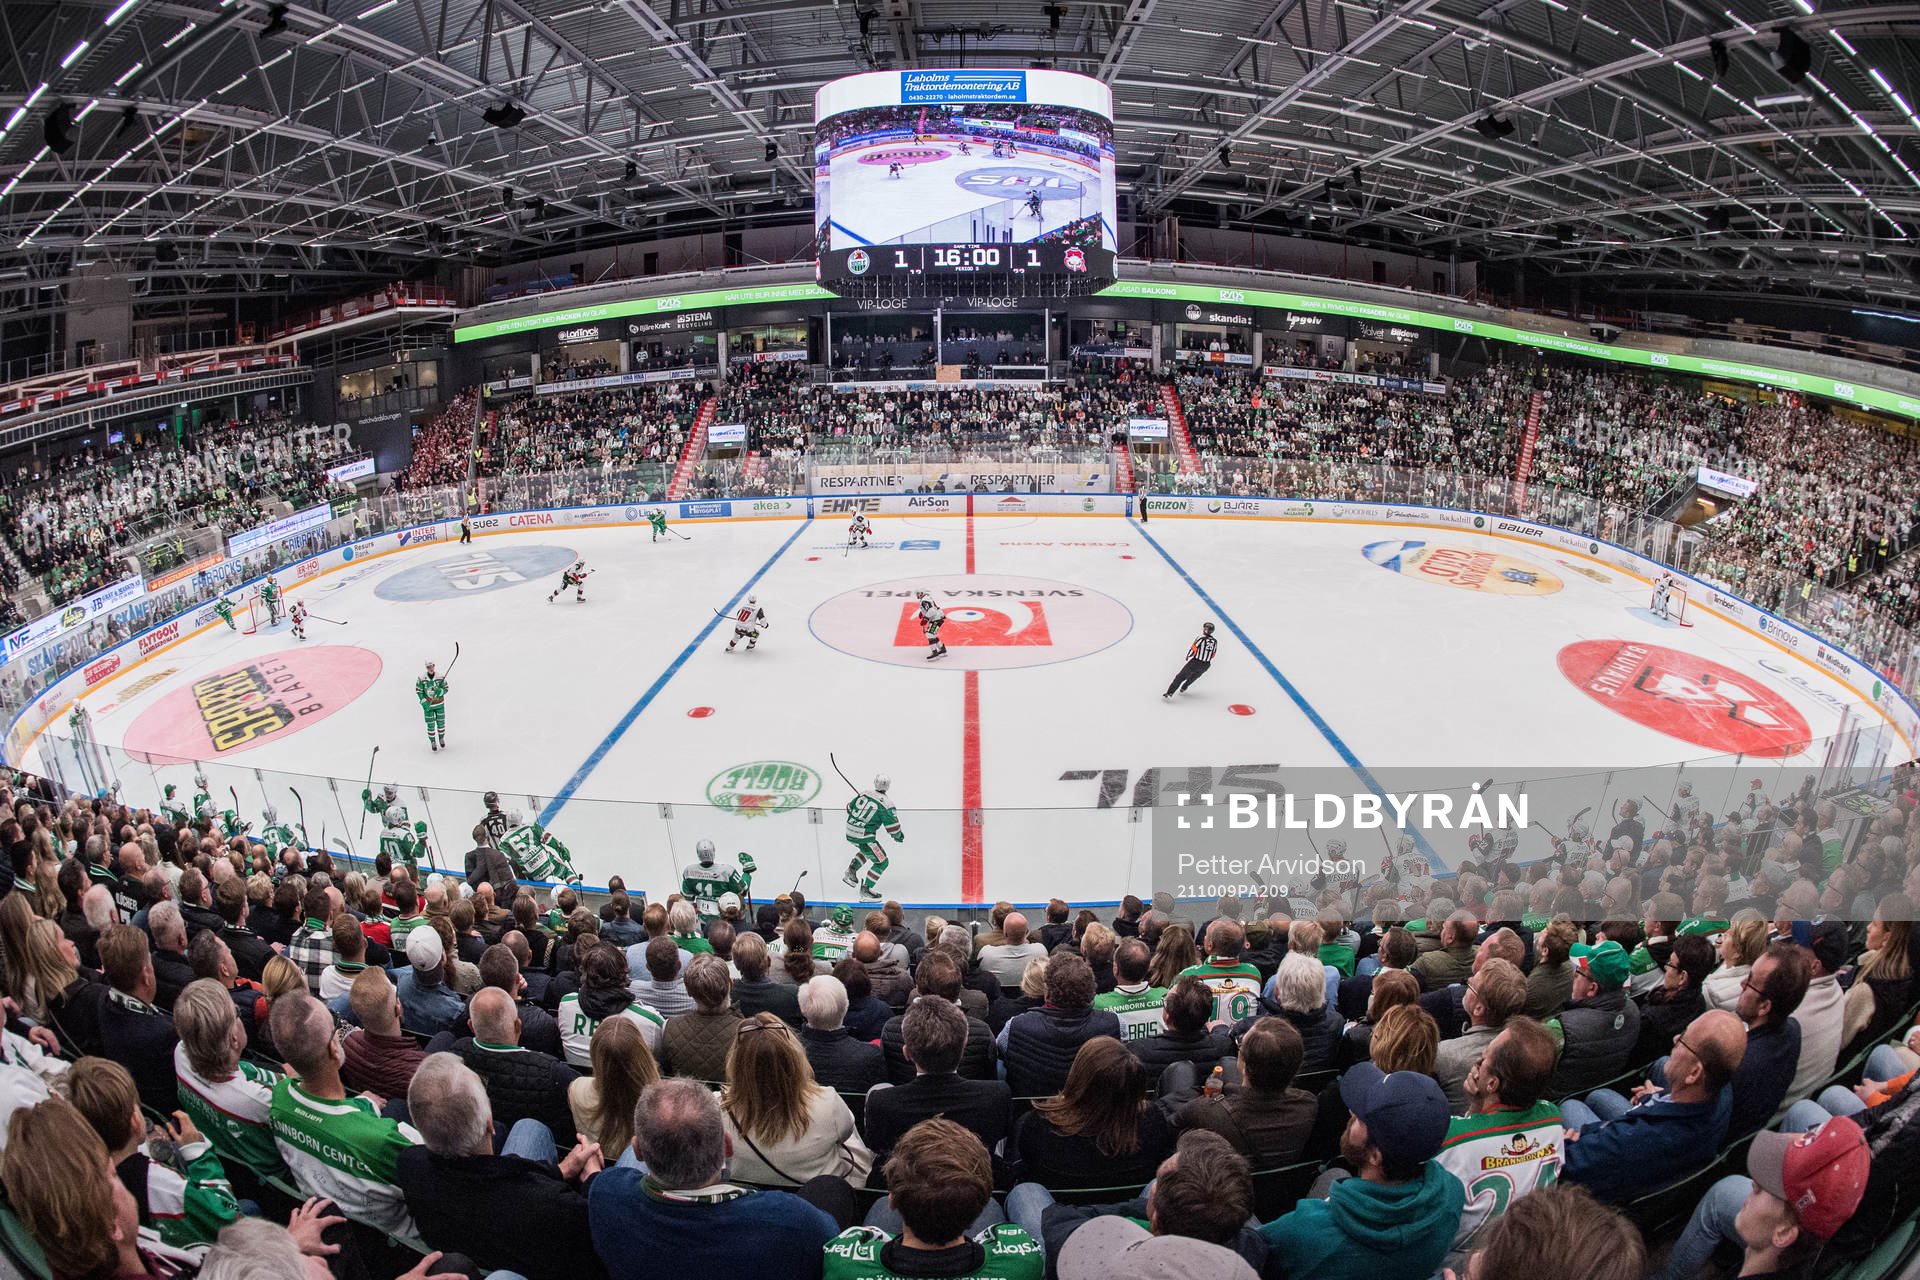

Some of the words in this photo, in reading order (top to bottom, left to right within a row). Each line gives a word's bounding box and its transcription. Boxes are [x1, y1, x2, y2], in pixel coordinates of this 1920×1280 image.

[906, 73, 950, 82] Laholms
[904, 82, 1004, 92] Traktordemontering
[1004, 82, 1020, 90] AB
[895, 250, 908, 268] 1
[934, 249, 1000, 266] 16:00
[1027, 249, 1041, 267] 1
[857, 298, 908, 310] VIP-LOGE
[967, 297, 1018, 308] VIP-LOGE
[685, 312, 712, 322] STENA
[677, 320, 713, 330] RECYCLING
[753, 501, 780, 511] akea
[908, 496, 950, 508] AirSon
[1147, 500, 1187, 510] GRIZON
[509, 514, 554, 527] CATENA
[412, 526, 436, 537] INTER
[1498, 522, 1543, 538] BAUER
[944, 589, 1085, 597] SVENSKA
[138, 621, 179, 650] FLYTGOLV
[1767, 620, 1798, 647] Brinova
[1591, 645, 1648, 696] BAUHAUS
[260, 657, 324, 717] BLADET
[851, 796, 878, 824] 90
[491, 823, 505, 836] 40
[508, 827, 535, 858] 67
